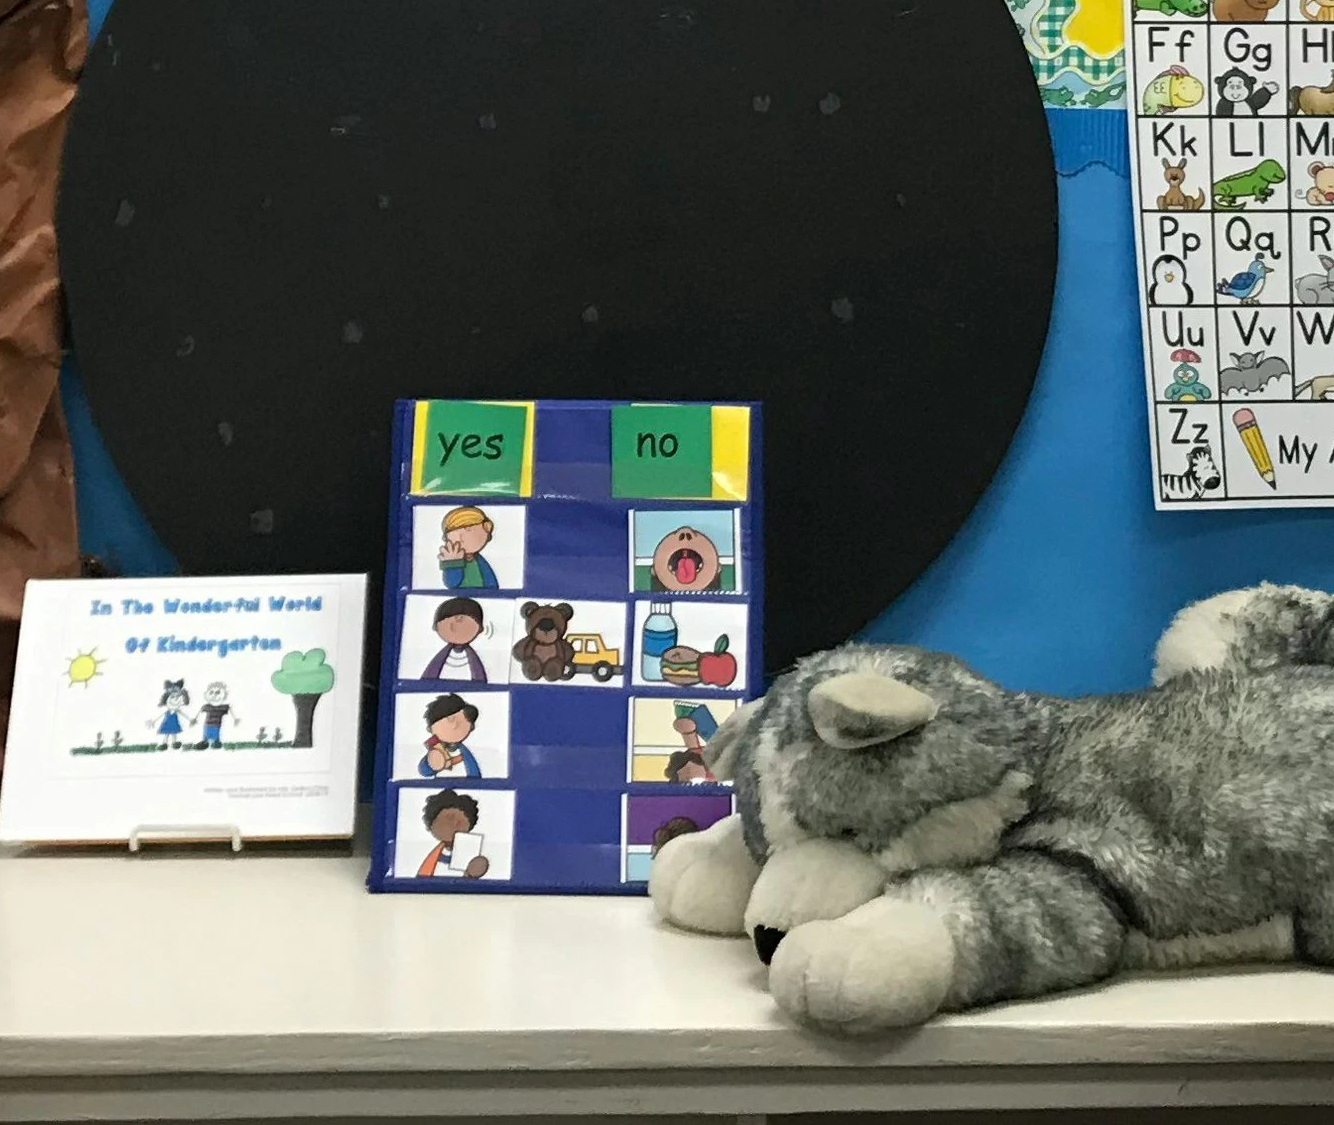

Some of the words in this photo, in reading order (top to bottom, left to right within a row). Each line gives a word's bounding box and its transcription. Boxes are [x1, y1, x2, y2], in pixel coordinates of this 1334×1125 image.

[1148, 27, 1195, 63] Ff
[1224, 27, 1271, 71] Gg
[1152, 122, 1197, 157] Kk
[1159, 216, 1201, 259] Pp
[1226, 216, 1280, 259] Qq
[1161, 311, 1204, 347] Uu
[1233, 311, 1276, 346] Vv
[1169, 408, 1209, 445] Zz
[437, 432, 504, 467] yes
[636, 431, 678, 458] no
[1280, 436, 1317, 473] My
[90, 599, 112, 616] In
[122, 599, 153, 614] The
[164, 597, 260, 614] Wonderful
[269, 596, 322, 613] World
[125, 636, 150, 654] Of
[157, 636, 281, 658] Kindergarten
